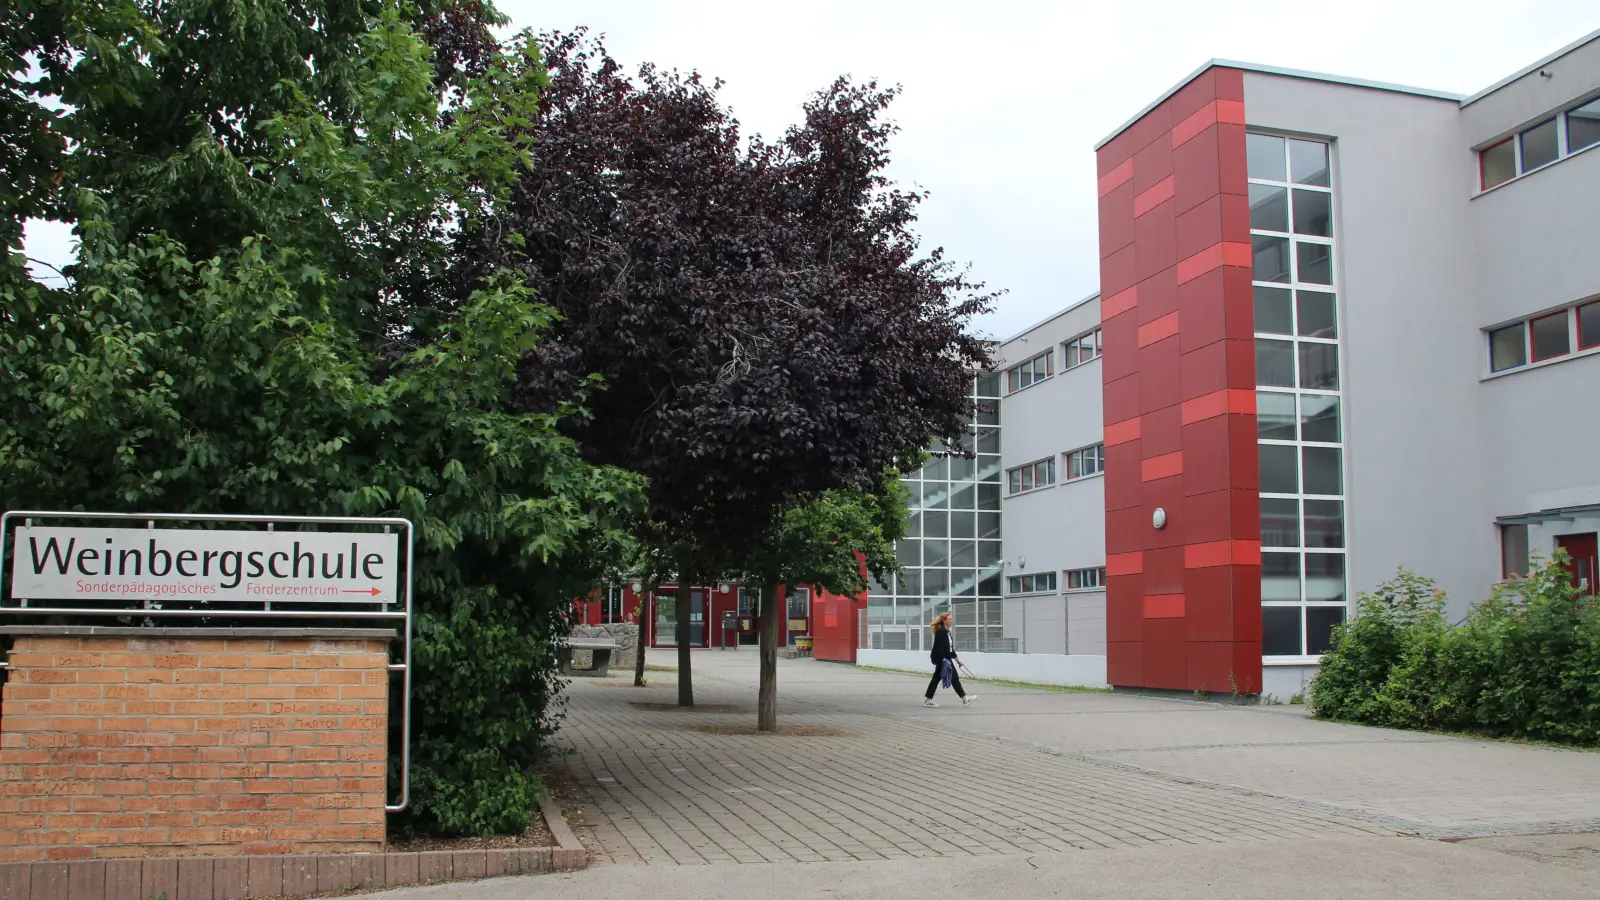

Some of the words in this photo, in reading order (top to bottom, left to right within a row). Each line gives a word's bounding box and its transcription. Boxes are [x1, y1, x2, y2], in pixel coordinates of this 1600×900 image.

[29, 536, 385, 589] Weinbergschule
[76, 580, 216, 595] Sonderpädagogisches
[246, 582, 339, 596] Förderzentrum
